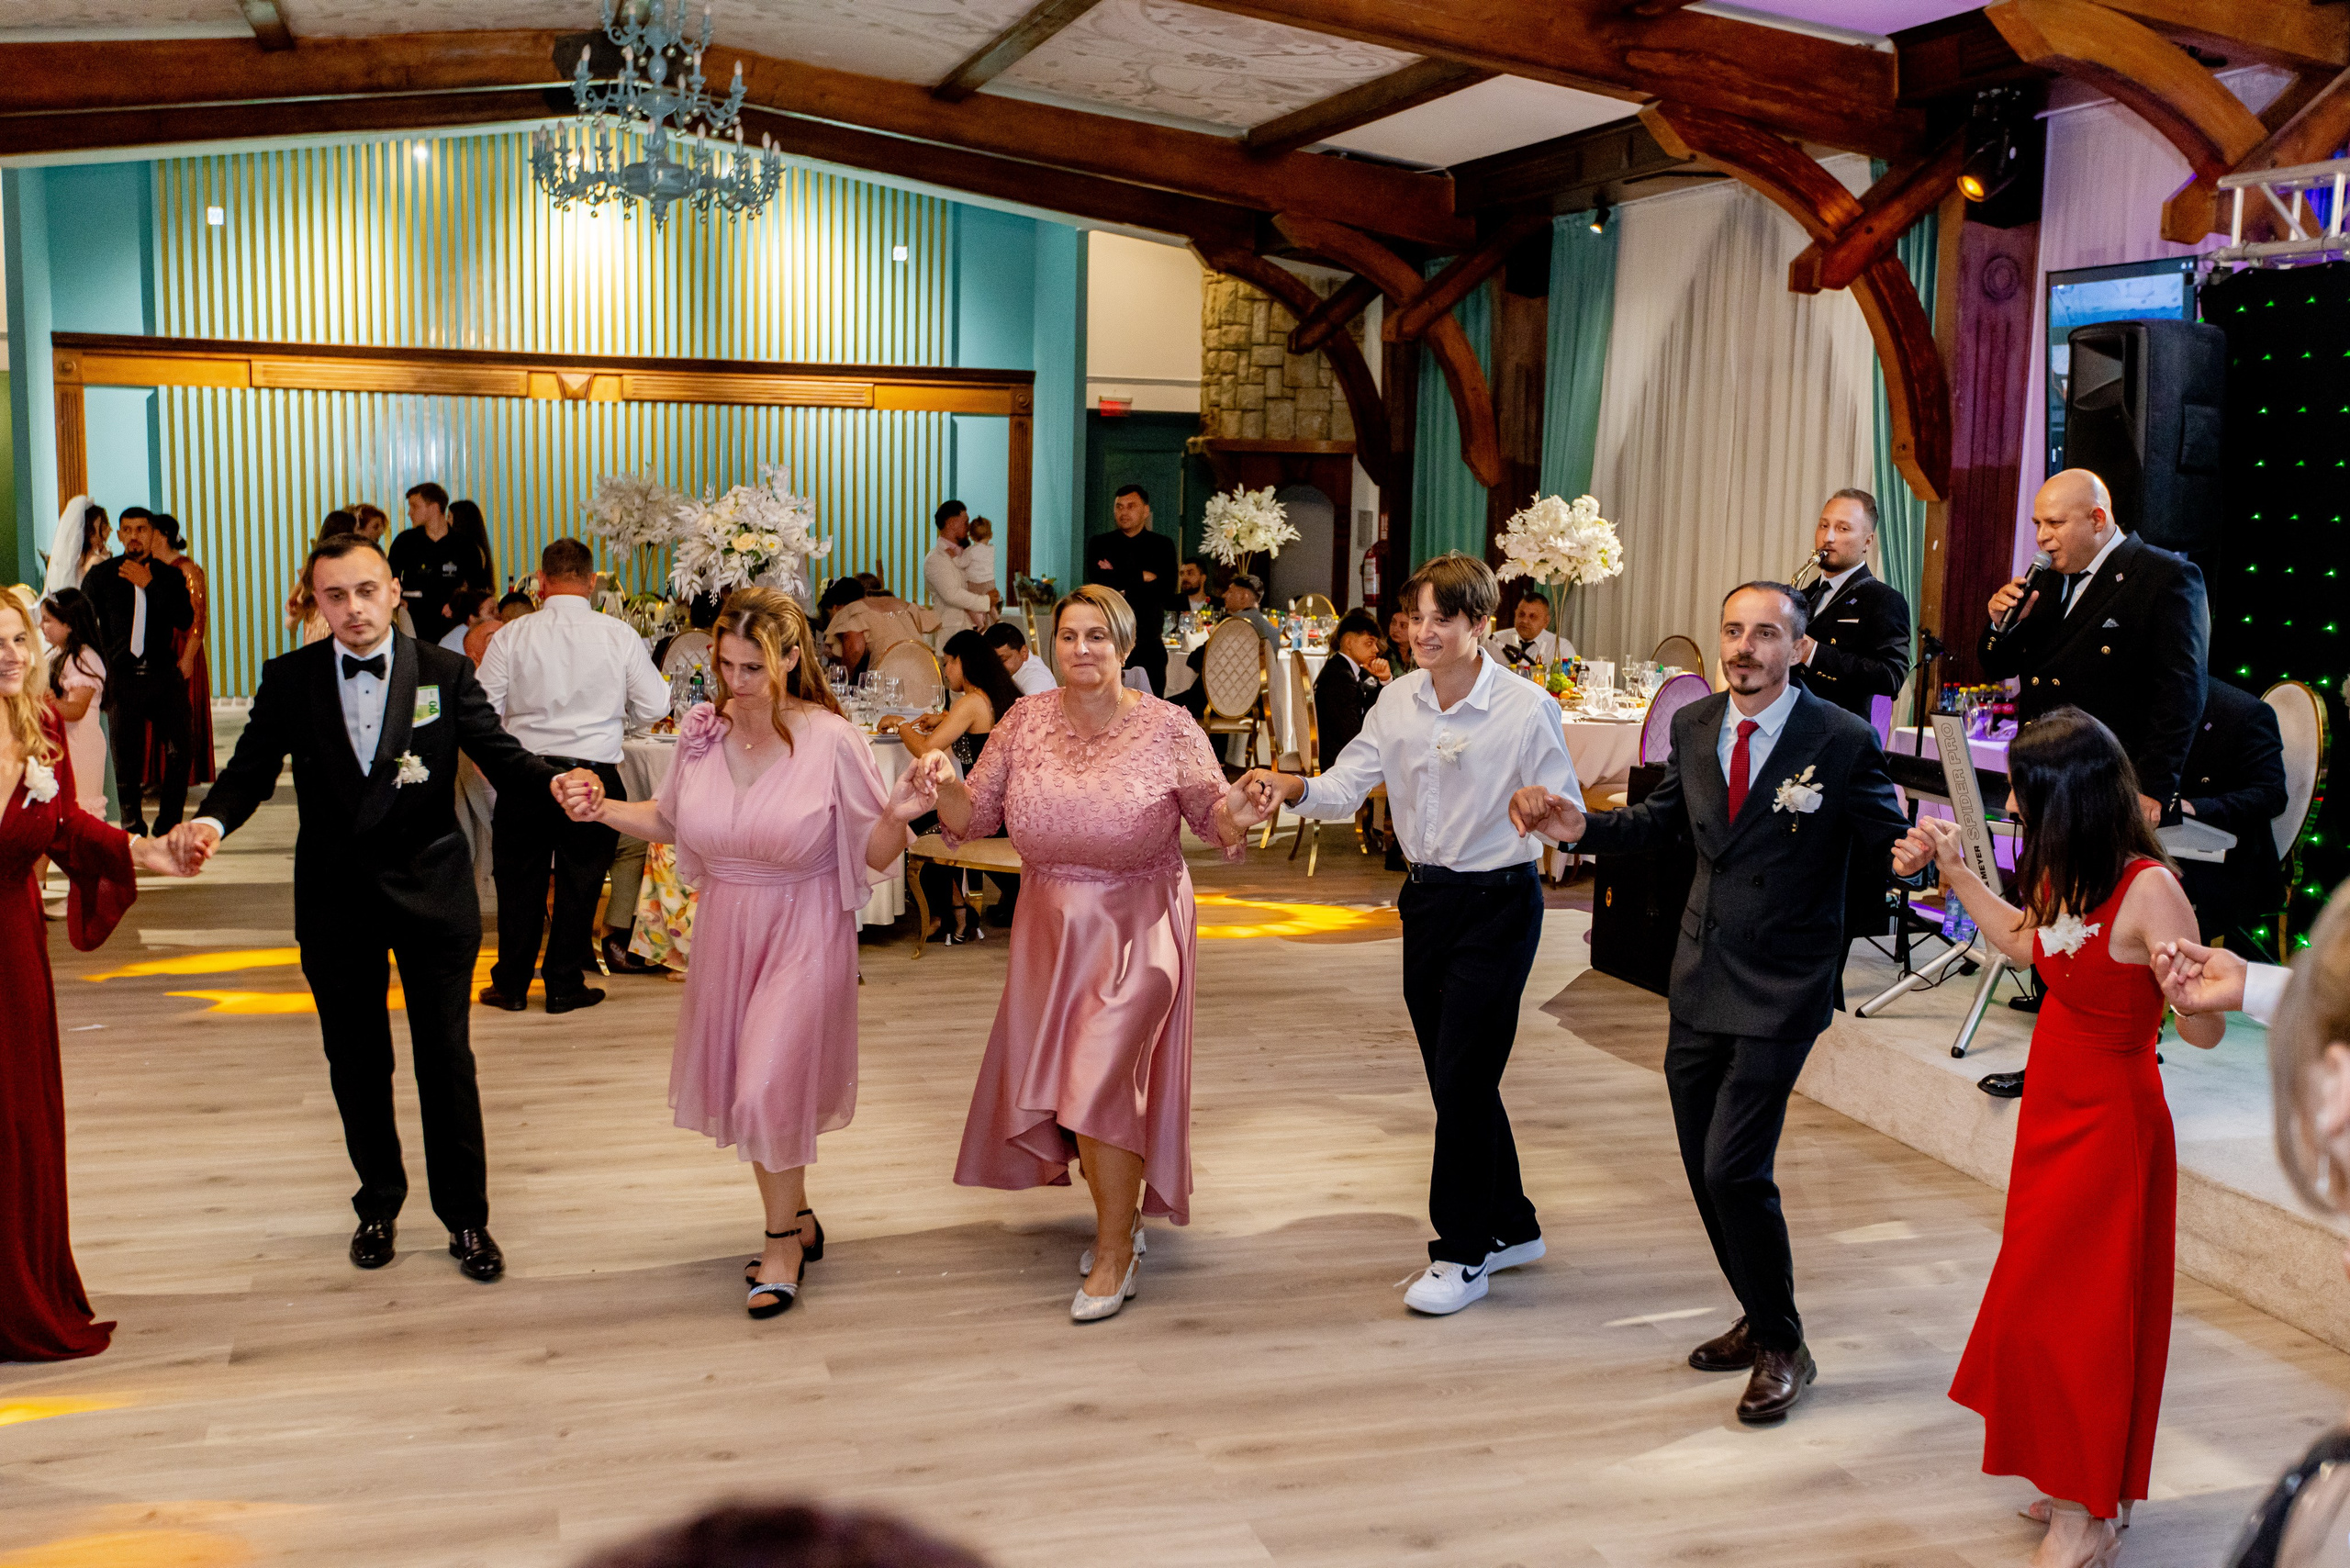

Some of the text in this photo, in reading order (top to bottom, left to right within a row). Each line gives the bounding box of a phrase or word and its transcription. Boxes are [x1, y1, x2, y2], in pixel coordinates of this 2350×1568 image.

[429, 700, 439, 716] 00
[1942, 722, 1962, 766] PRO
[1952, 768, 1980, 841] SPIDER
[1974, 846, 1987, 879] MEYER
